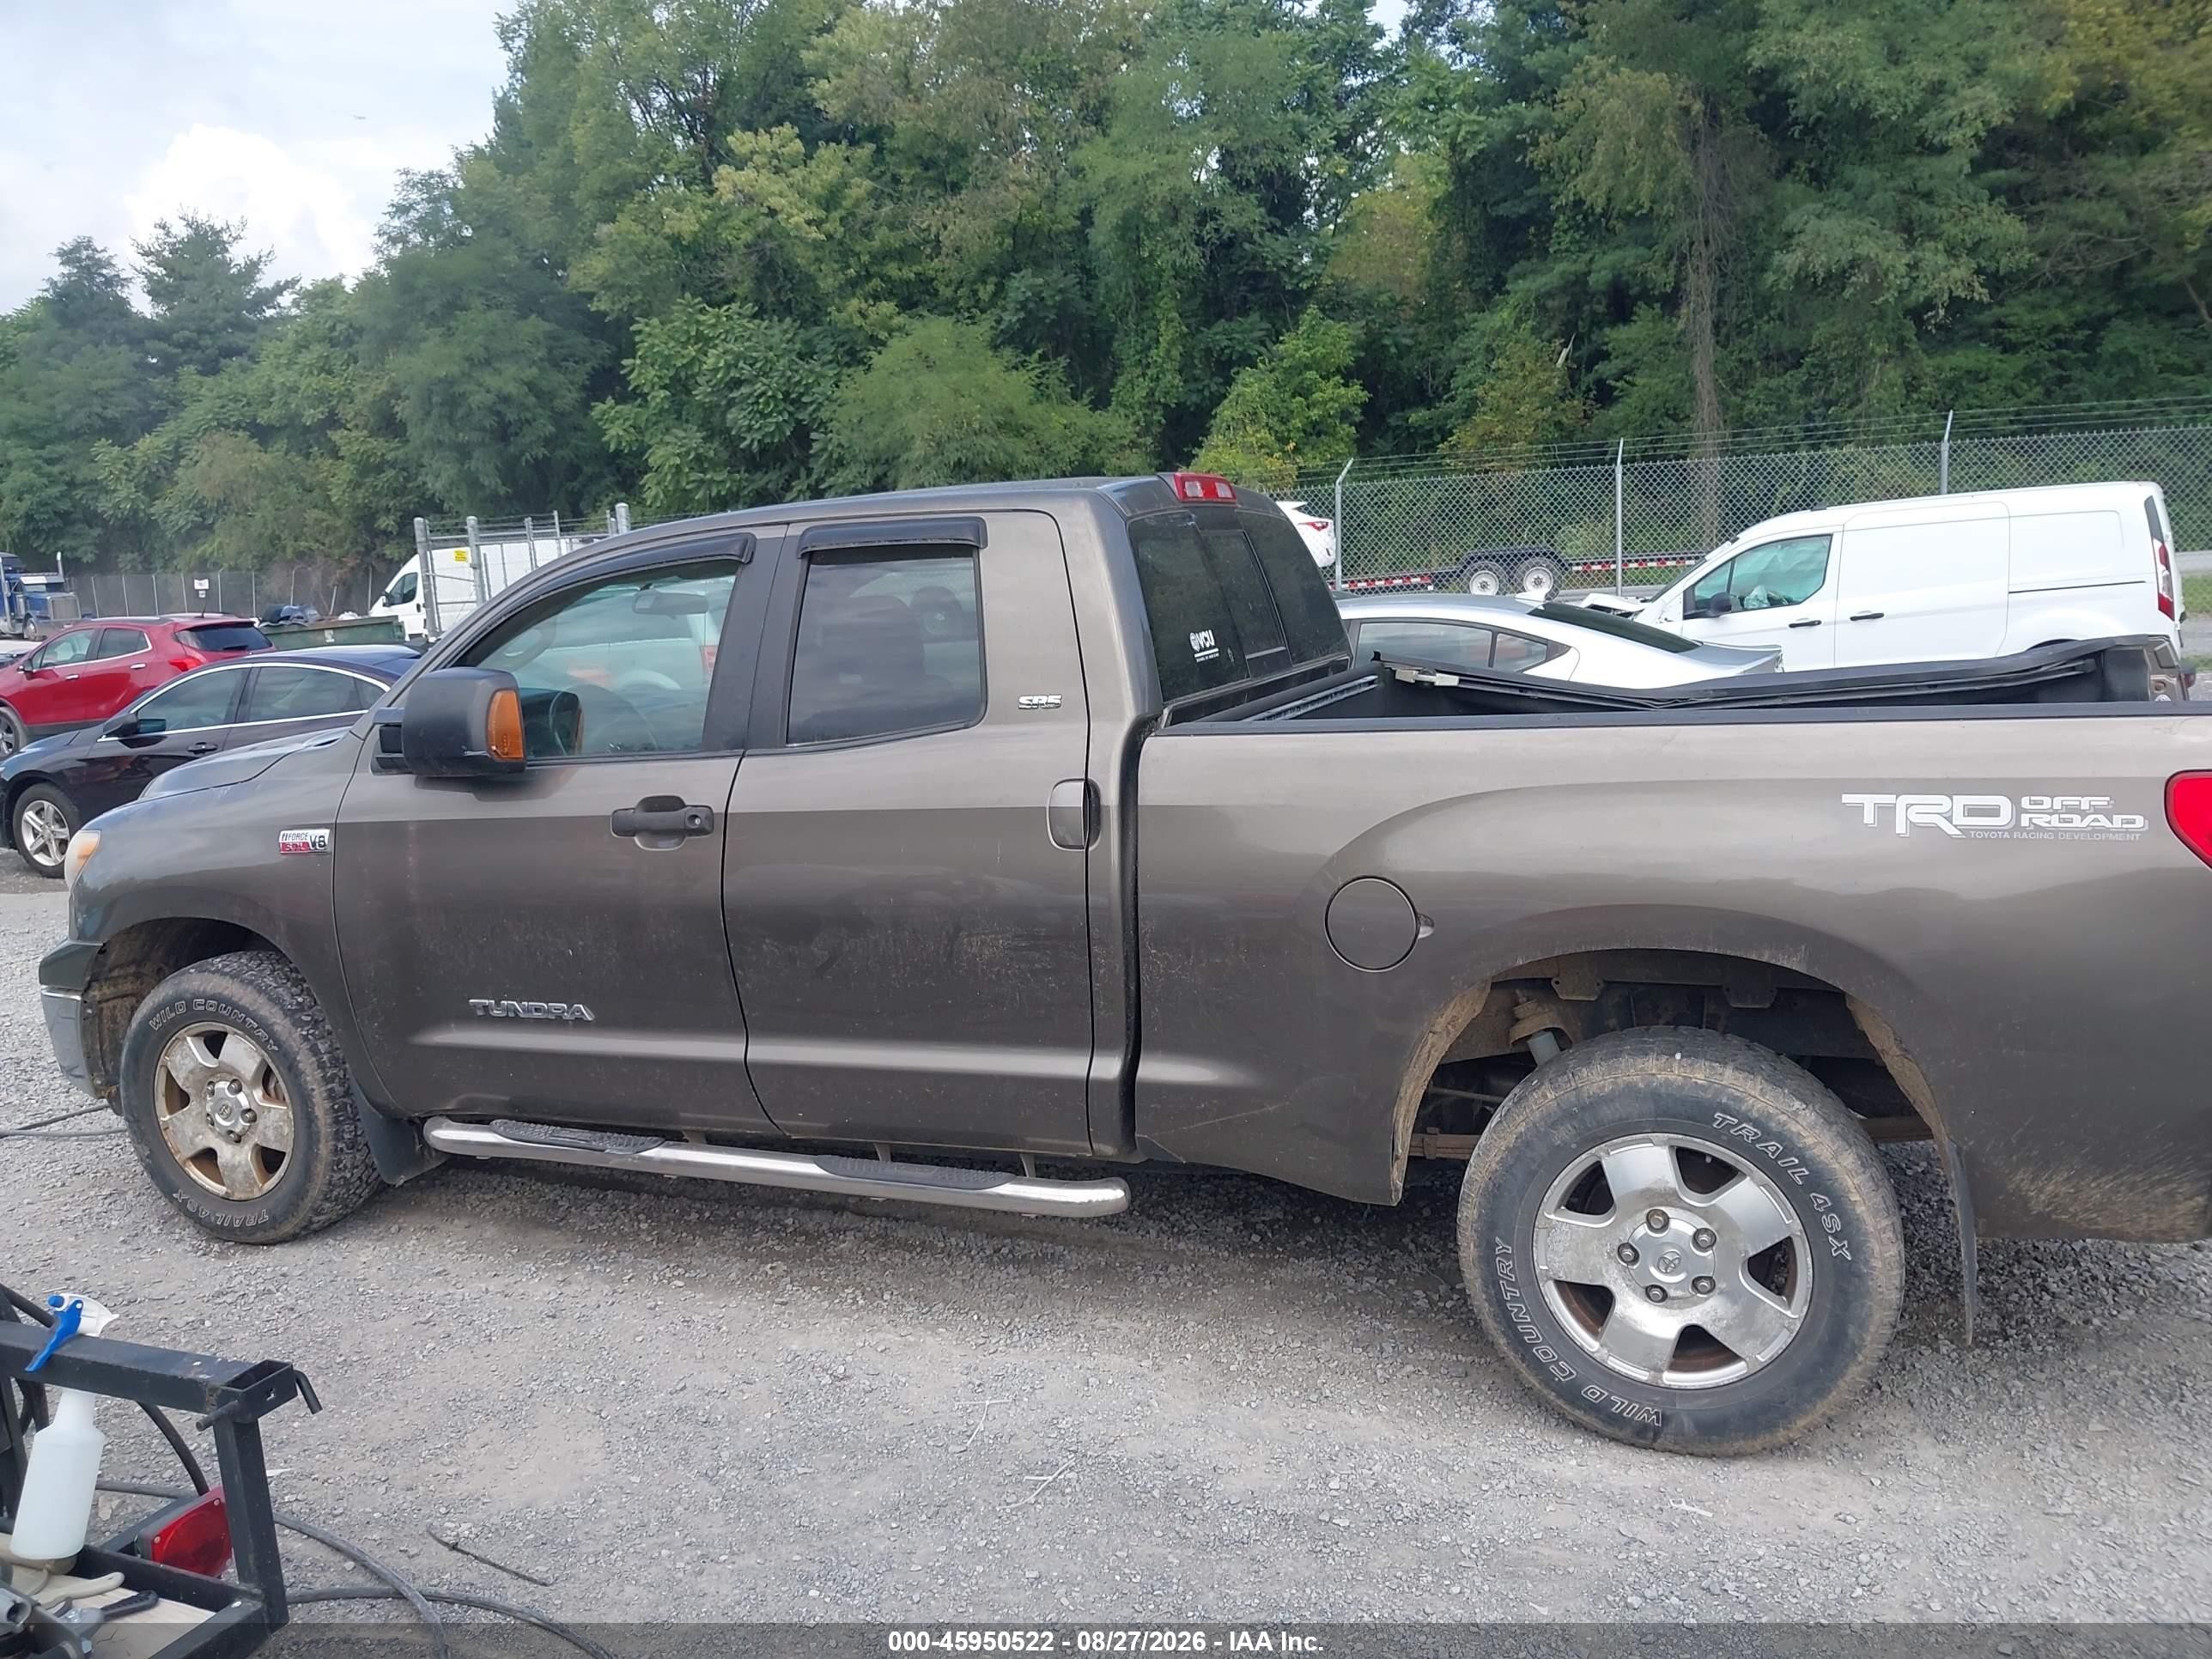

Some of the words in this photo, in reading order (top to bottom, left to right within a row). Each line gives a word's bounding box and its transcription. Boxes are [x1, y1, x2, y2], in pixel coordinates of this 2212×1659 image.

[1018, 695, 1062, 709] SR5
[1841, 793, 2015, 838] TRD
[2021, 796, 2114, 812] OFF
[2021, 813, 2148, 831] ROAD
[310, 835, 326, 848] V8
[1970, 830, 2010, 839] TOYOTA
[2014, 831, 2055, 840] RACING
[2058, 831, 2142, 842] DEVELOPMENT
[469, 1000, 595, 1021] TUNDRA
[149, 1000, 186, 1030] WILD
[193, 999, 278, 1051] COUNTRY
[1713, 1113, 1810, 1185] TRAIL
[1809, 1193, 1852, 1261] 4SX
[216, 1209, 269, 1227] TRAIL
[1495, 1237, 1577, 1382] COUNTRY
[1581, 1385, 1662, 1426] WILD
